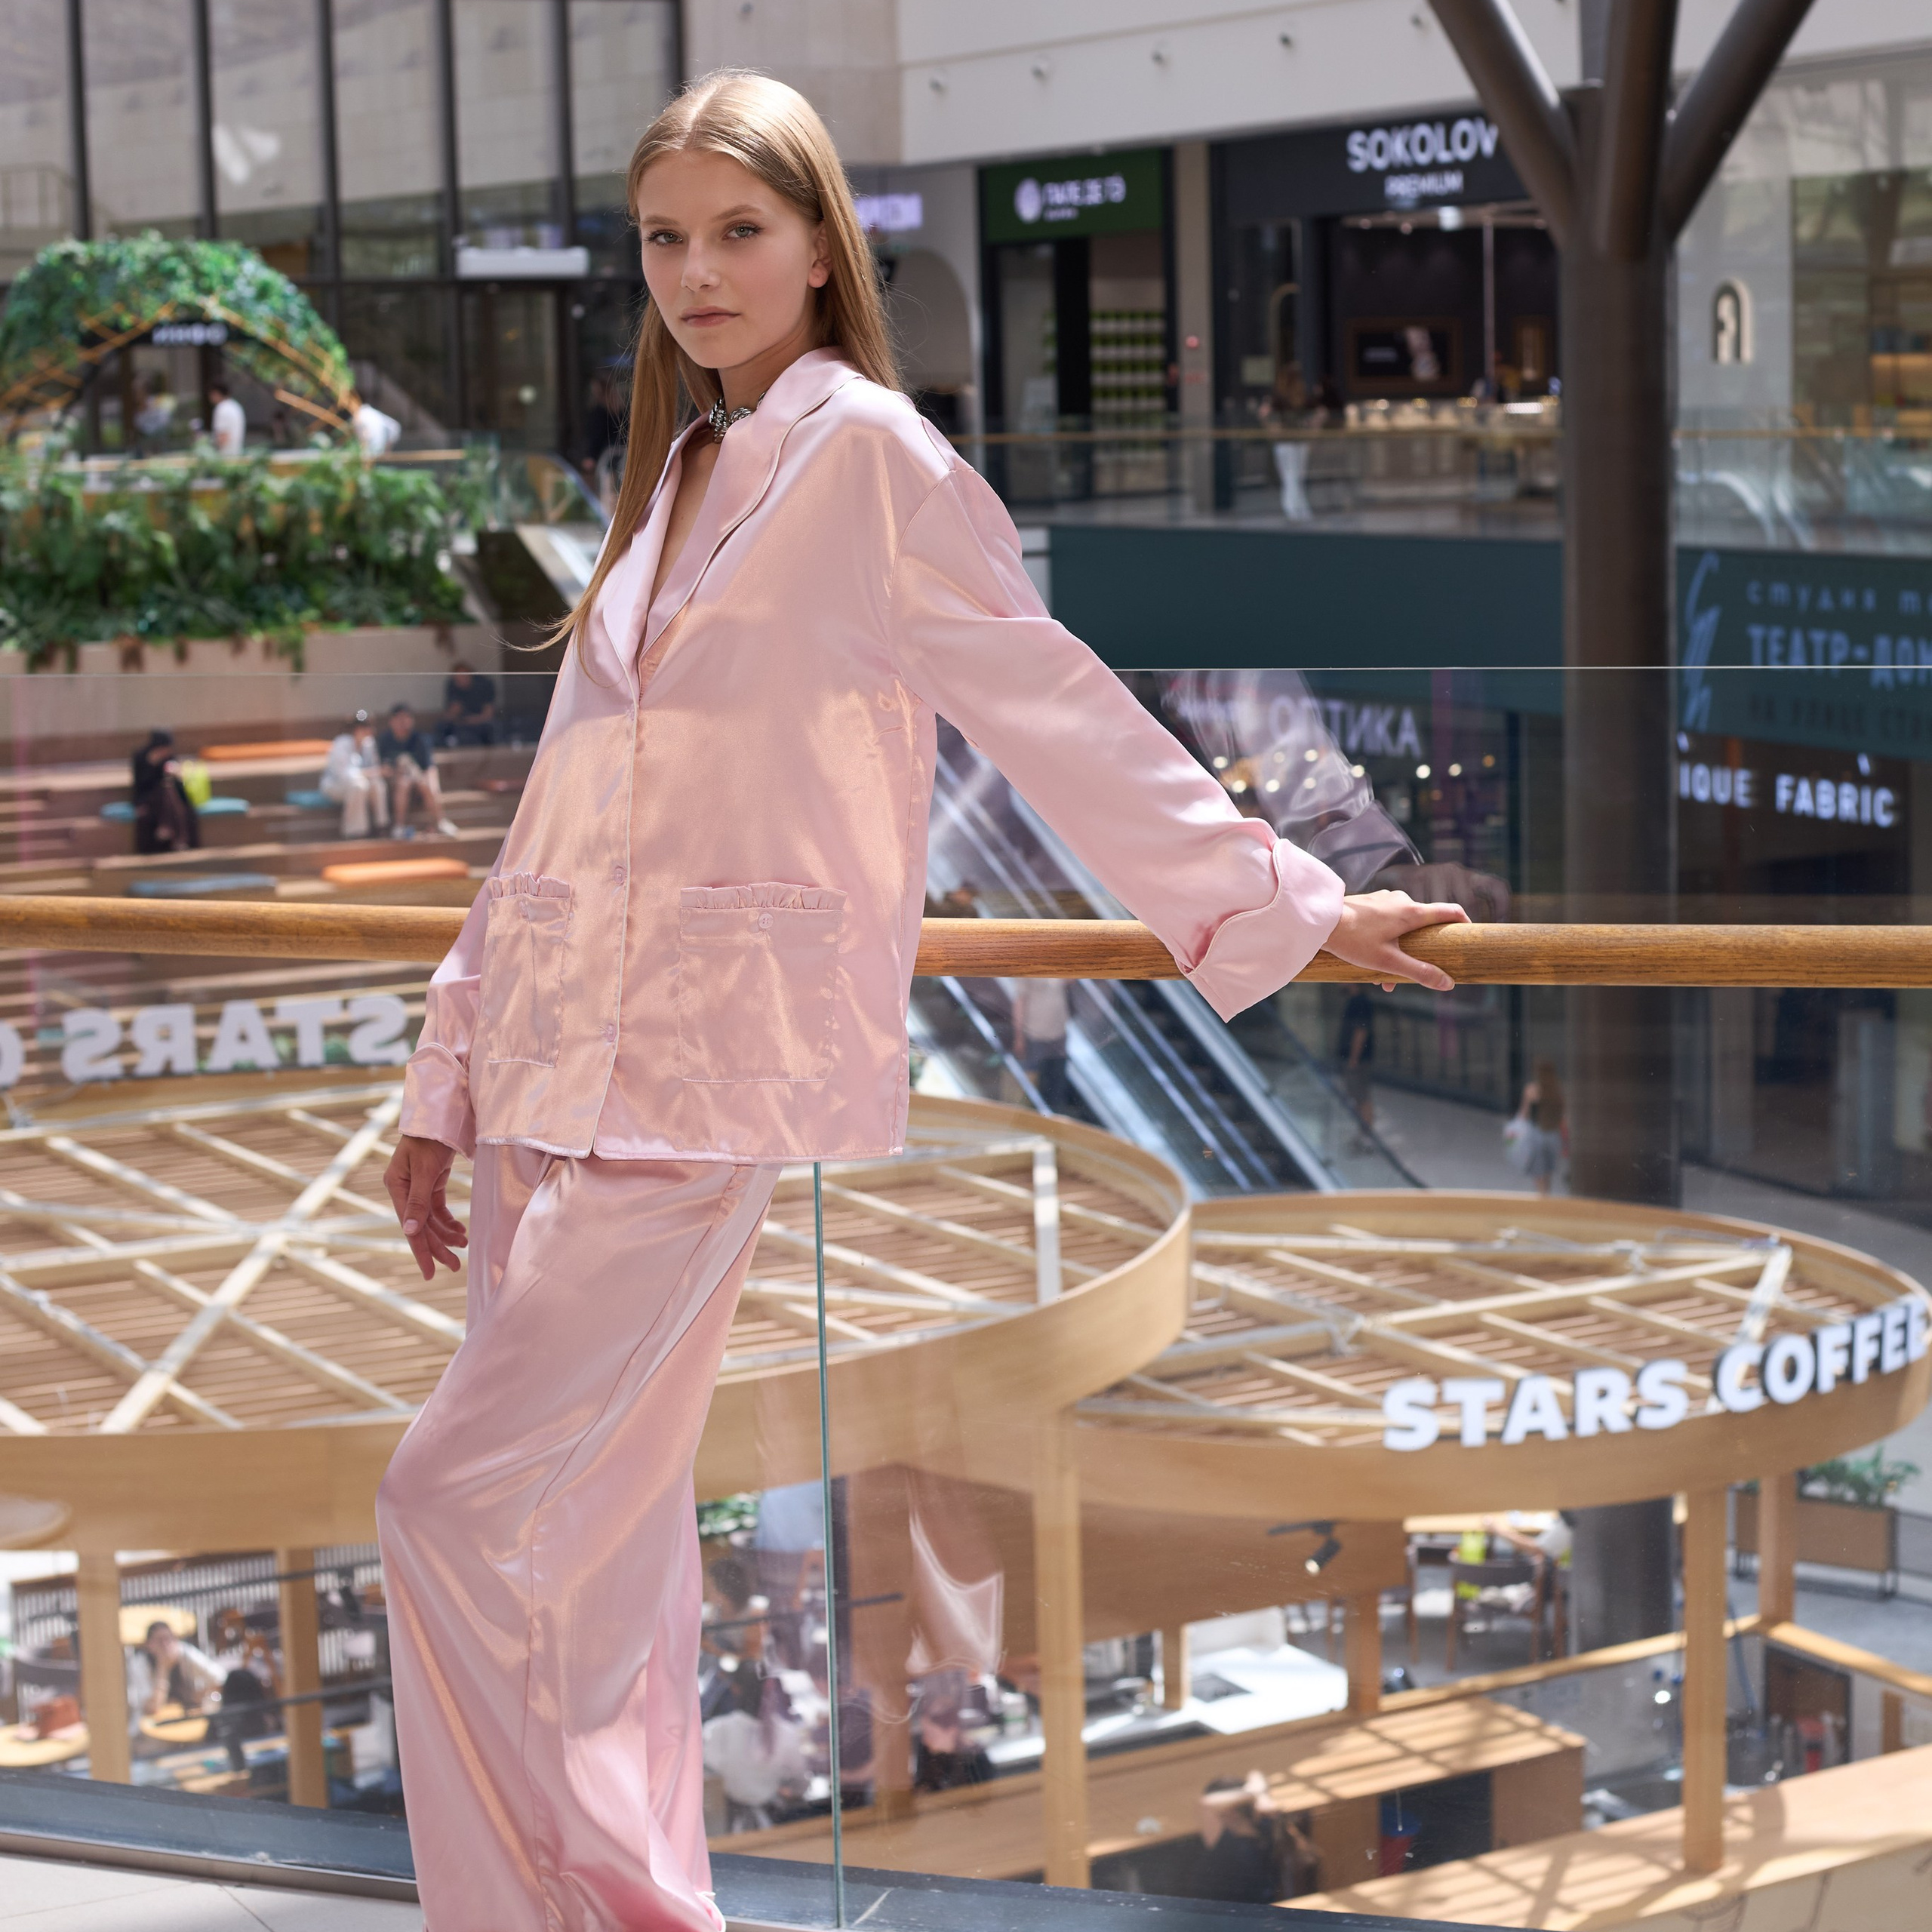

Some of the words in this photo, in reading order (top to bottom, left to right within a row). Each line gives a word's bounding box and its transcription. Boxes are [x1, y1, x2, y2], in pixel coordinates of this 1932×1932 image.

[1346, 116, 1499, 173] SOKOLOV
[1774, 772, 1895, 828] FABRIC
[1381, 1358, 1690, 1451] STARS
[1712, 1294, 1930, 1414] COFFEE
